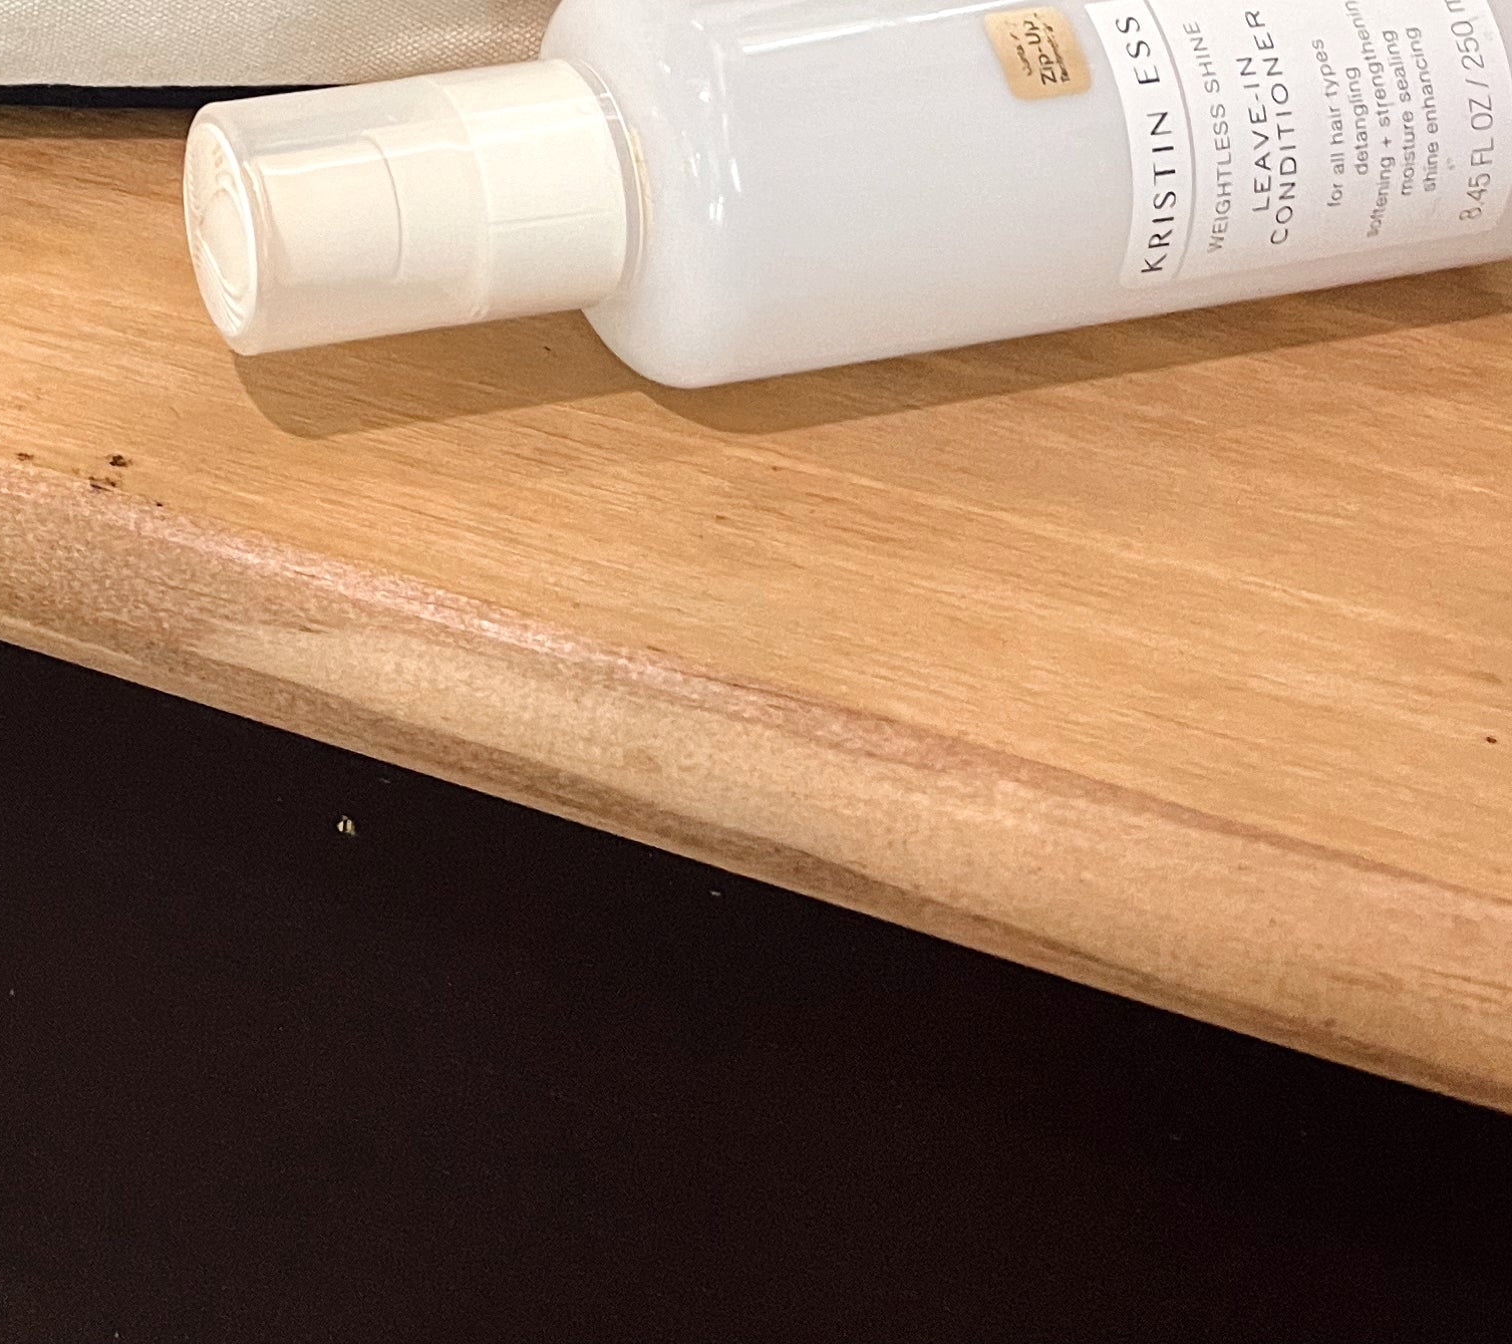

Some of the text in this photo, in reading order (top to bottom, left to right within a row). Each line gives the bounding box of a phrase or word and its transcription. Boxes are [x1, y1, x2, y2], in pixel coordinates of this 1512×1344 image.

[1023, 19, 1057, 86] Zip-Up
[1450, 19, 1485, 71] 250
[1465, 77, 1490, 90] /
[1115, 15, 1177, 273] KRISTIN ESS
[1182, 20, 1233, 254] WEIGHTLESS SHINE
[1235, 56, 1272, 213] LEAVE-IN
[1244, 10, 1297, 245] CONDITIONER
[1311, 38, 1345, 208] for all hair types
[1345, 65, 1369, 177] detangling
[1382, 29, 1416, 197] moisture sealing
[1382, 136, 1393, 148] +
[1405, 26, 1440, 193] shine enhancing
[1468, 94, 1494, 132] OZ
[1470, 136, 1494, 168] FL
[1458, 172, 1491, 222] 8.45
